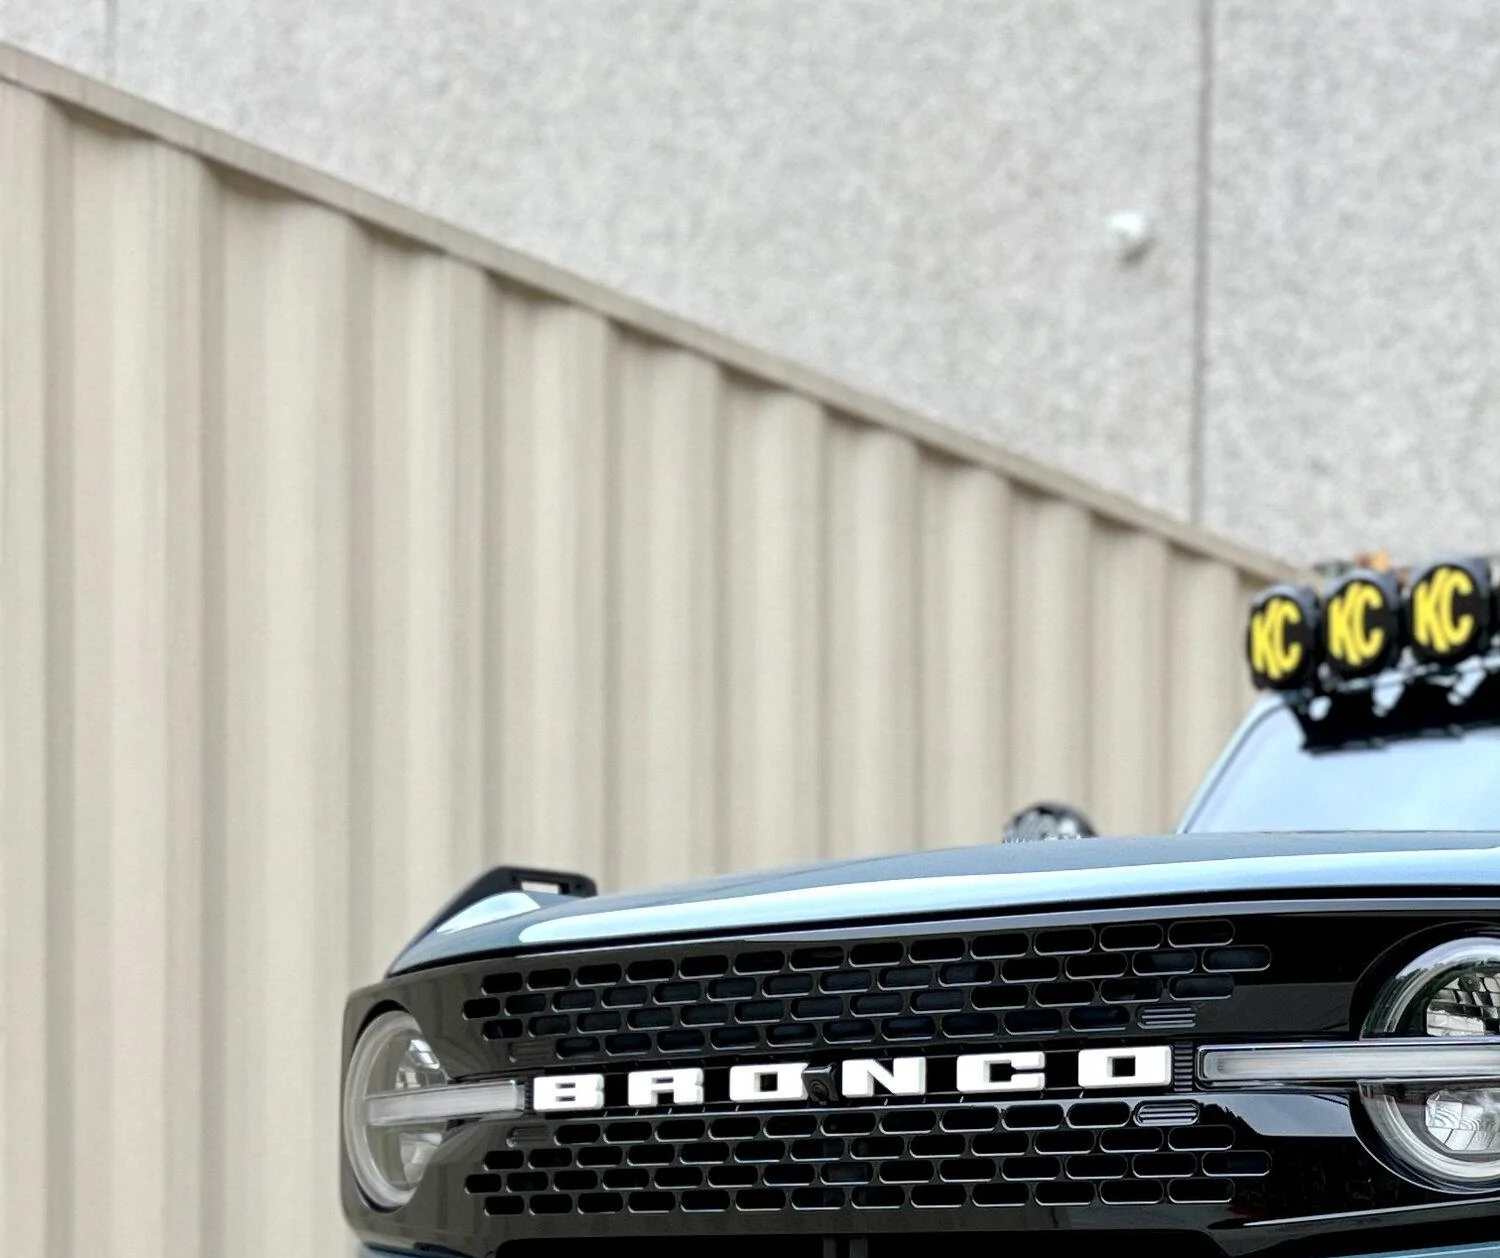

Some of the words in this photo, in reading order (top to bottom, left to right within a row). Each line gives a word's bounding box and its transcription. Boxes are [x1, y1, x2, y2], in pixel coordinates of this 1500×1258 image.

[1249, 599, 1302, 678] KC
[1327, 582, 1384, 666] KC
[1413, 566, 1475, 654] KC
[532, 1044, 1173, 1114] BRONCO
